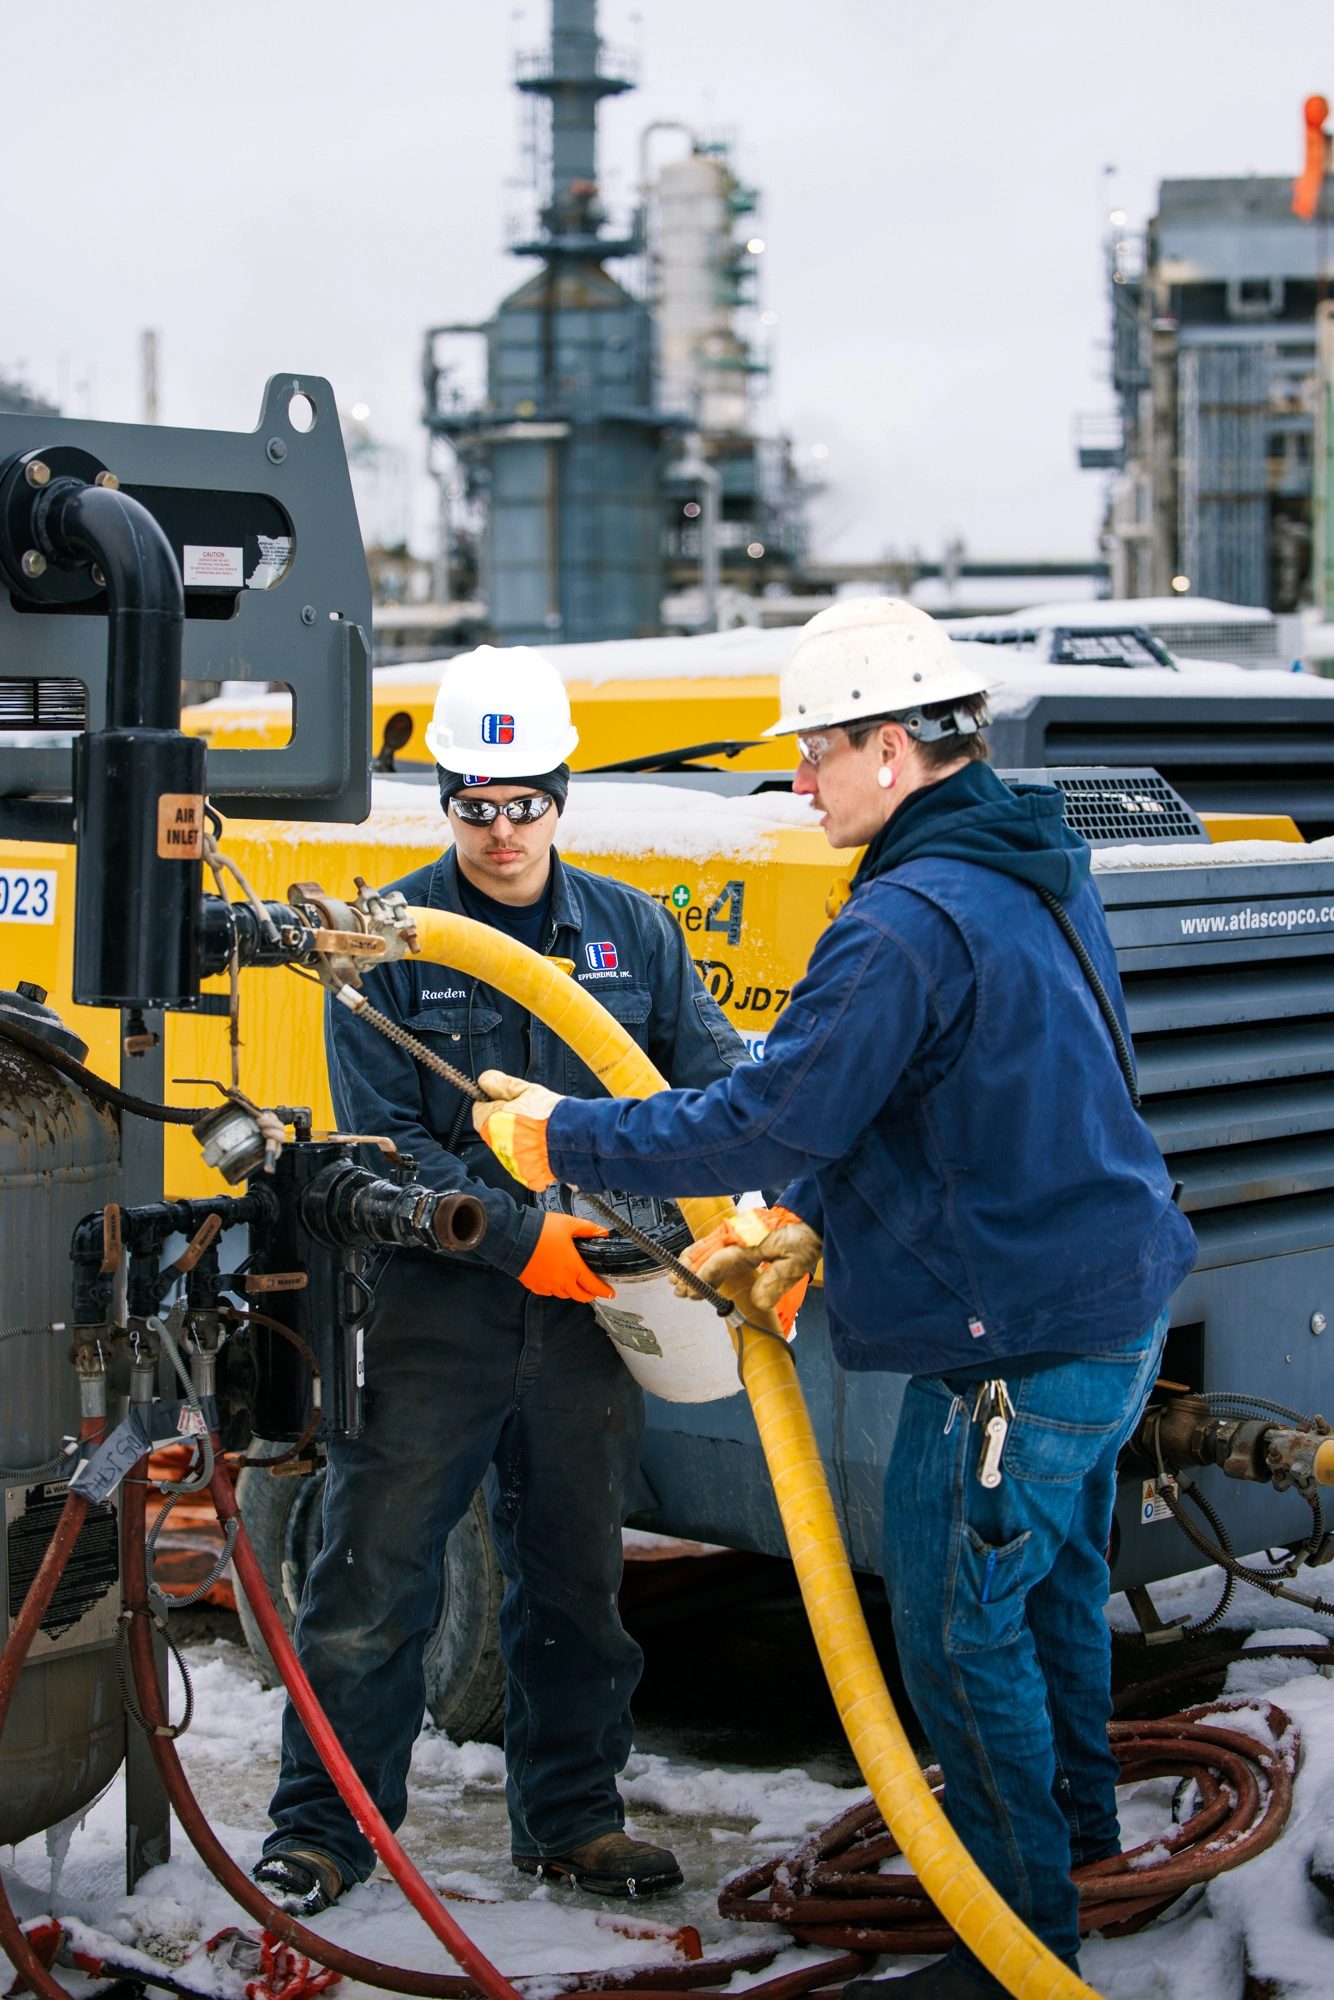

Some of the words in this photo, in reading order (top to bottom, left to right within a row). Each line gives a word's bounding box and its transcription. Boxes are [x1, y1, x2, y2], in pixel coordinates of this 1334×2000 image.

[174, 808, 195, 824] AIR
[166, 829, 199, 845] INLET
[577, 970, 619, 981] EPPERHEIMER,
[620, 970, 633, 978] INC.
[421, 987, 467, 1001] Raeden
[734, 986, 790, 1013] JD7
[198, 1224, 215, 1246] Marco
[277, 1277, 301, 1286] Marco
